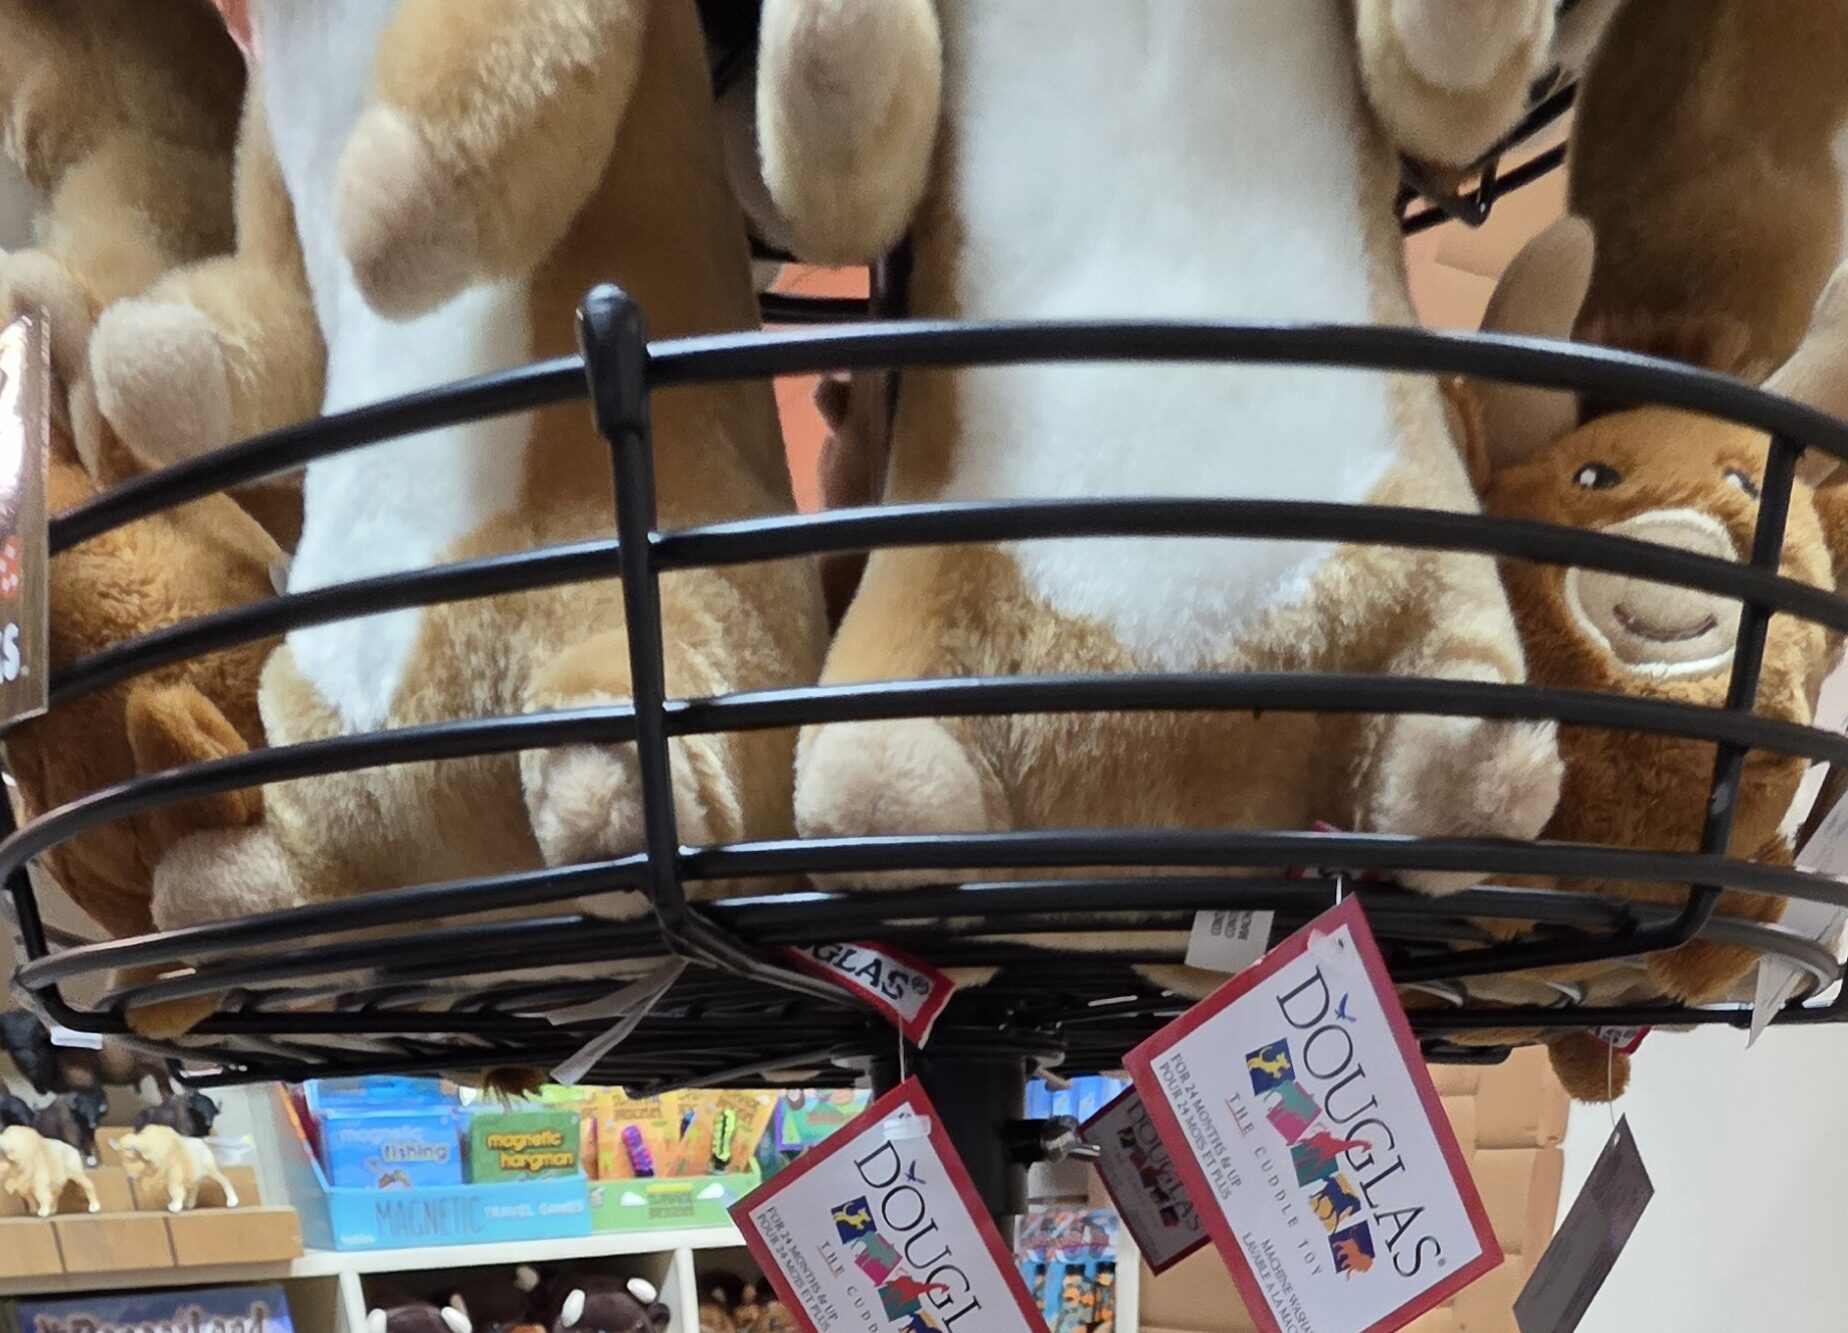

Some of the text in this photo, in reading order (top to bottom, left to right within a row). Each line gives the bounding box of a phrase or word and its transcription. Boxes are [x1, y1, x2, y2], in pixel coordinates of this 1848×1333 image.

[382, 1144, 448, 1163] fishing
[487, 1131, 563, 1150] magnetic
[1158, 1060, 1184, 1102] POUR
[1176, 1098, 1191, 1117] 24
[1201, 1149, 1217, 1171] ET
[1209, 1167, 1232, 1201] PLUS
[1169, 1052, 1191, 1084] FOR
[1183, 1081, 1199, 1101] 24
[1191, 1097, 1226, 1157] MONTHS
[1225, 1168, 1242, 1190] UP
[500, 1153, 574, 1171] hangman
[1227, 1091, 1322, 1279] THE CUDDLE TOY
[375, 1196, 483, 1237] MAGNETIC
[755, 1212, 780, 1246] POUR
[773, 1243, 788, 1261] 24
[799, 1287, 815, 1306] ET
[808, 1303, 831, 1332] PLUS
[764, 1205, 786, 1232] FOR
[779, 1229, 794, 1246] 24
[787, 1243, 822, 1294] MONTHS
[823, 1304, 839, 1323] UP
[818, 1238, 846, 1277] THE
[1240, 1231, 1272, 1284] LAVABLE
[1269, 1290, 1285, 1310] LA
[1259, 1237, 1294, 1297] MACHINE
